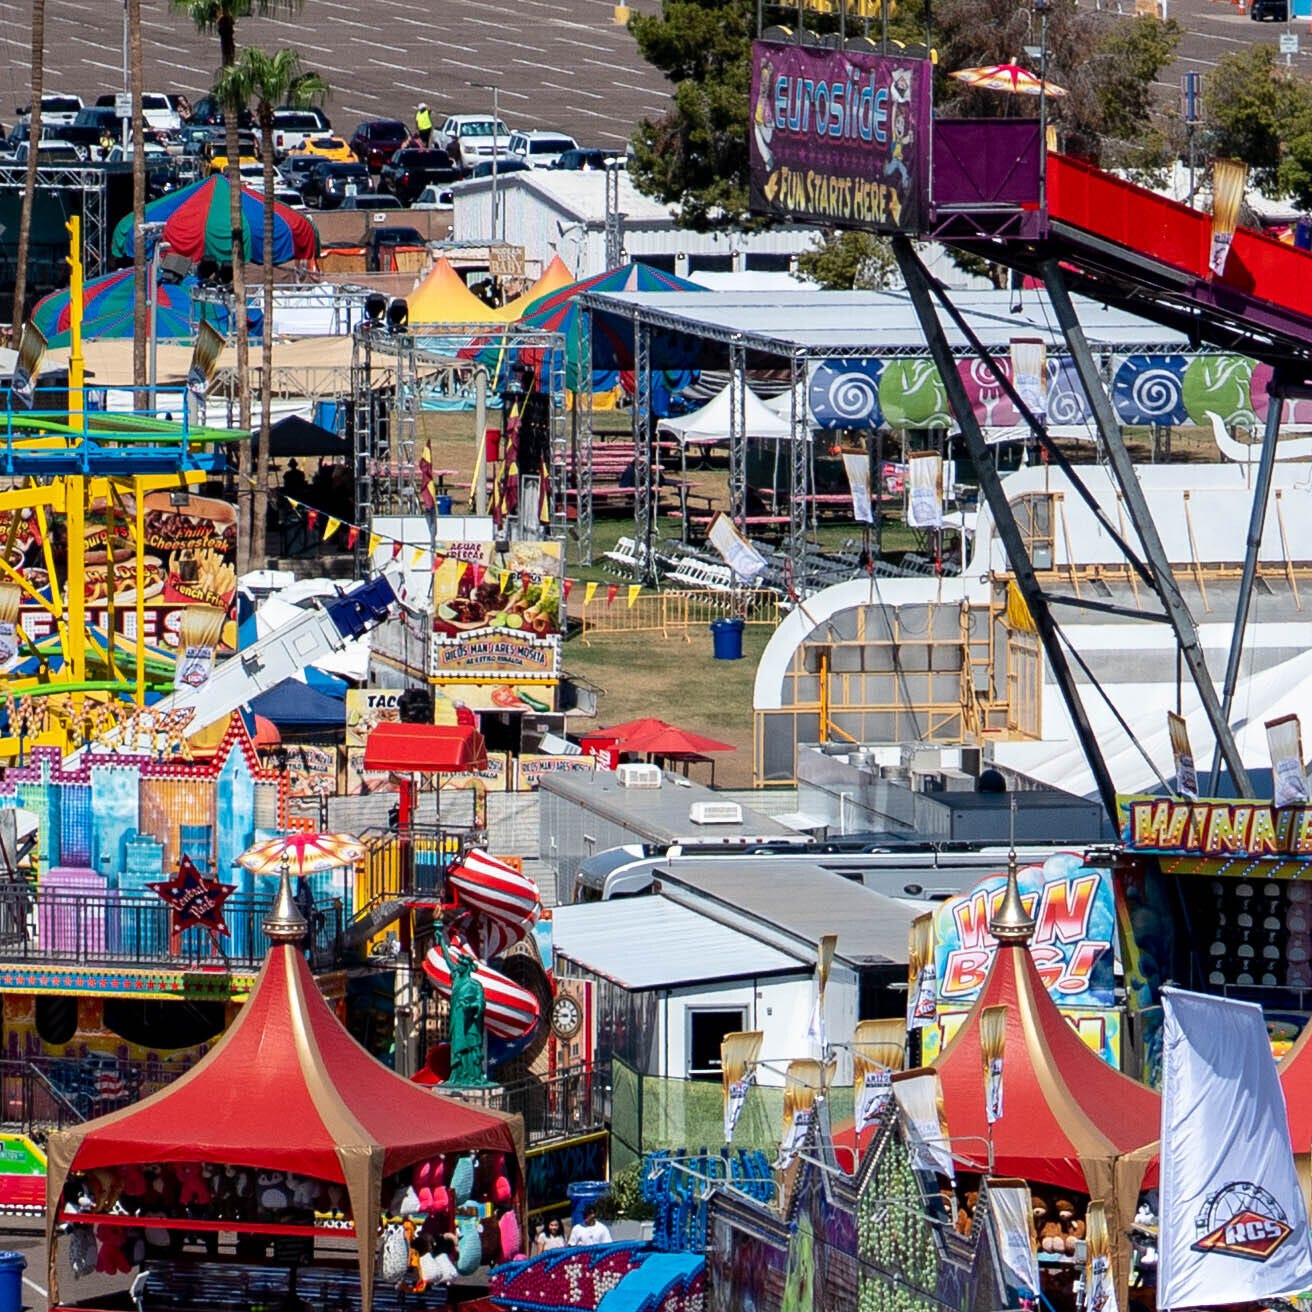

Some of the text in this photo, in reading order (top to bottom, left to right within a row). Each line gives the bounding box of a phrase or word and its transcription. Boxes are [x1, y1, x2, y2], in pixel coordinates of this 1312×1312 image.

[779, 166, 887, 223] FUN STARTS HERE
[150, 535, 229, 552] Cheesesteak
[63, 695, 198, 764] YORK
[169, 880, 208, 912] Central
[188, 896, 214, 919] Park
[941, 941, 1111, 997] BG!
[1223, 1217, 1283, 1246] RCS
